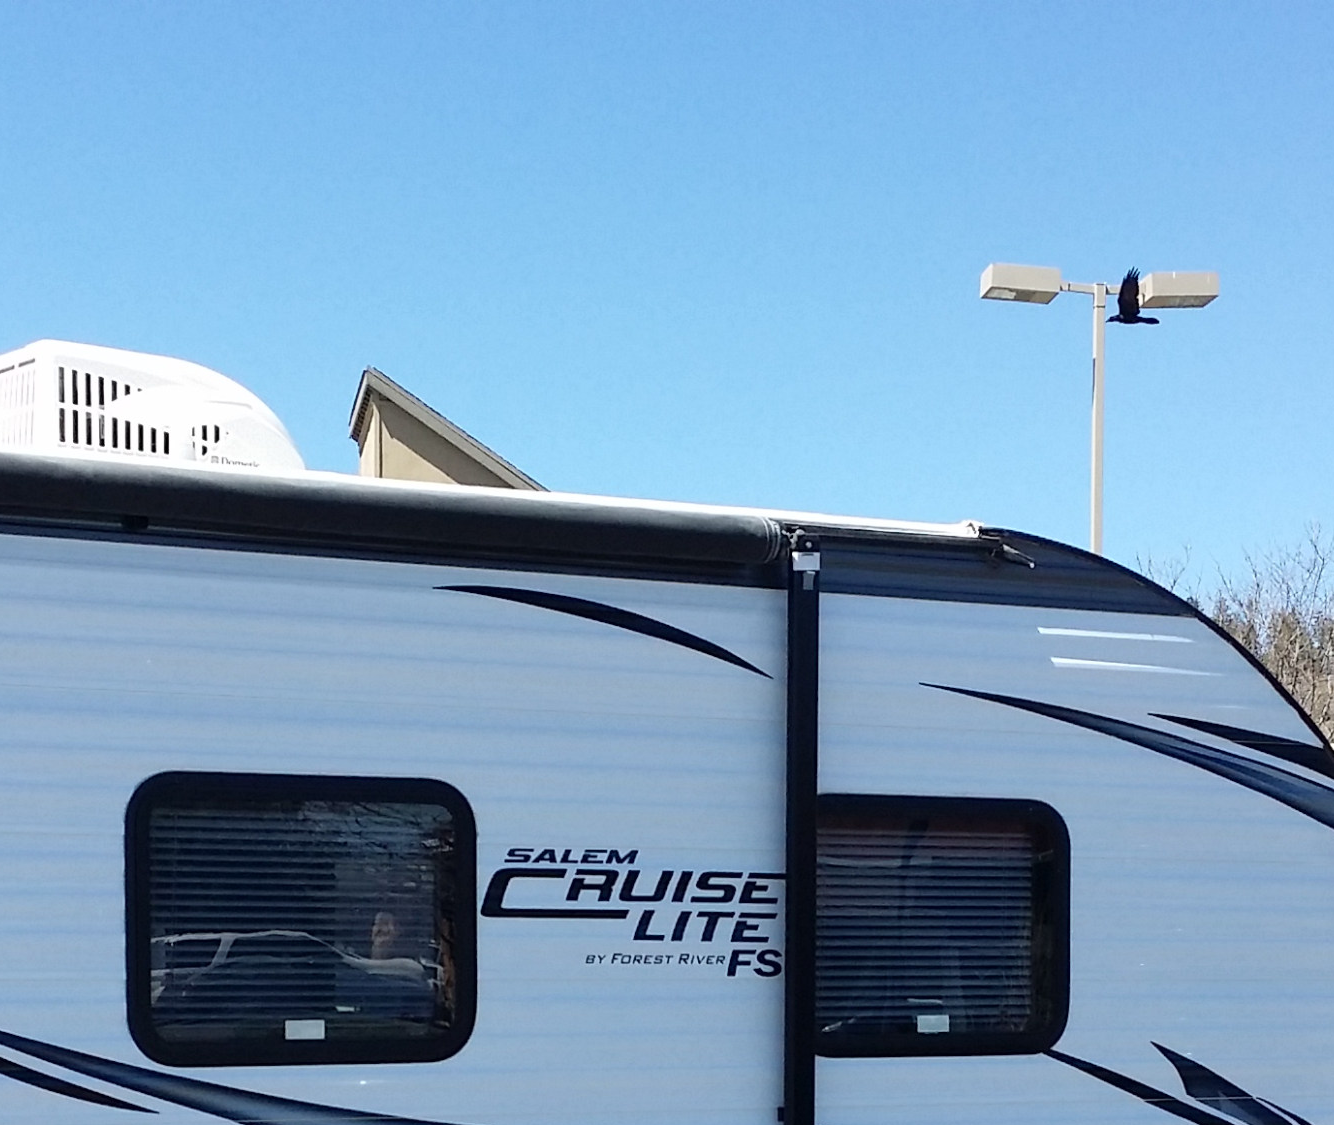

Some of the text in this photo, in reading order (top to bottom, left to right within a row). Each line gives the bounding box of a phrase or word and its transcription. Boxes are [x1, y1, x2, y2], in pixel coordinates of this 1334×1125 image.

[503, 848, 639, 865] SALEM
[480, 867, 786, 920] CRUISE
[632, 909, 778, 943] LITE
[585, 953, 607, 965] BY
[726, 949, 783, 978] FS
